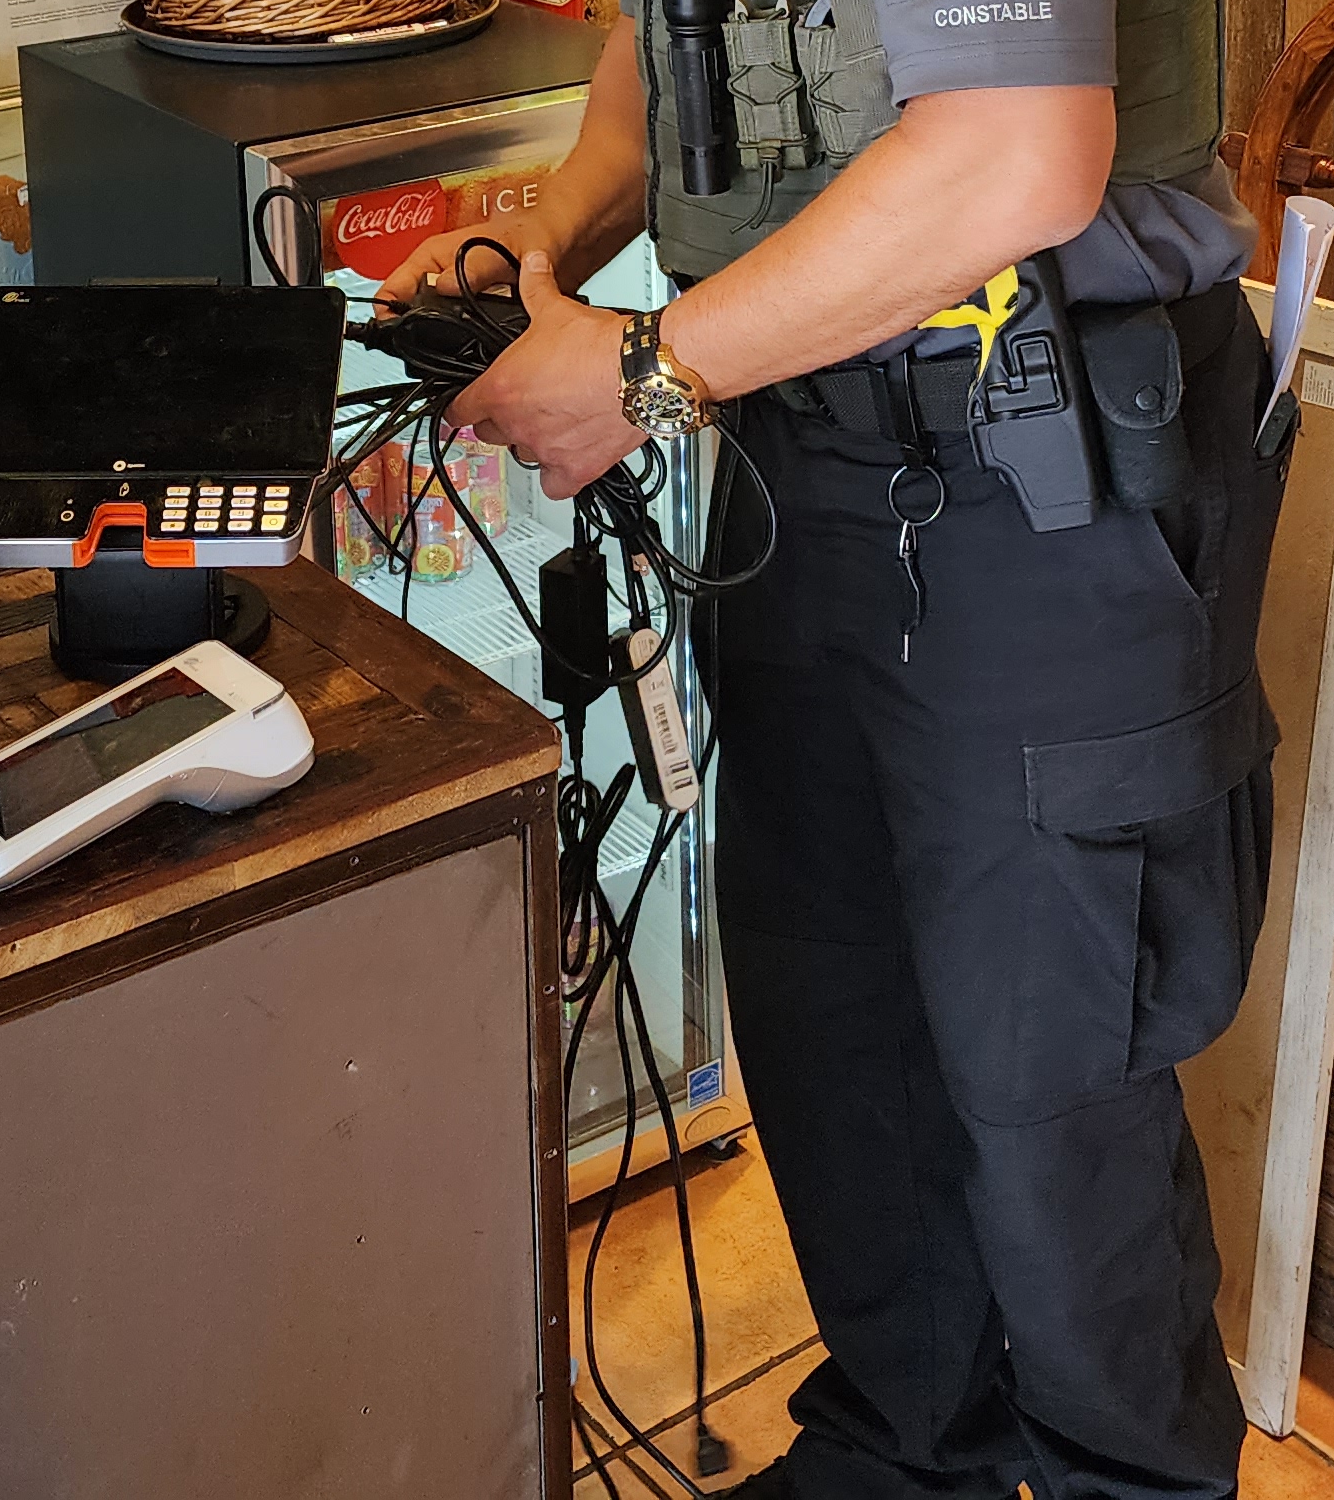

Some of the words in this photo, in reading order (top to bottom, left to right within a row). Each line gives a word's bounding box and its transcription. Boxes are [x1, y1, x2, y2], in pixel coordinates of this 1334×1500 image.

[934, 0, 1053, 28] CONSTABLE
[337, 188, 440, 245] Coca-Cola
[481, 183, 539, 218] ICE
